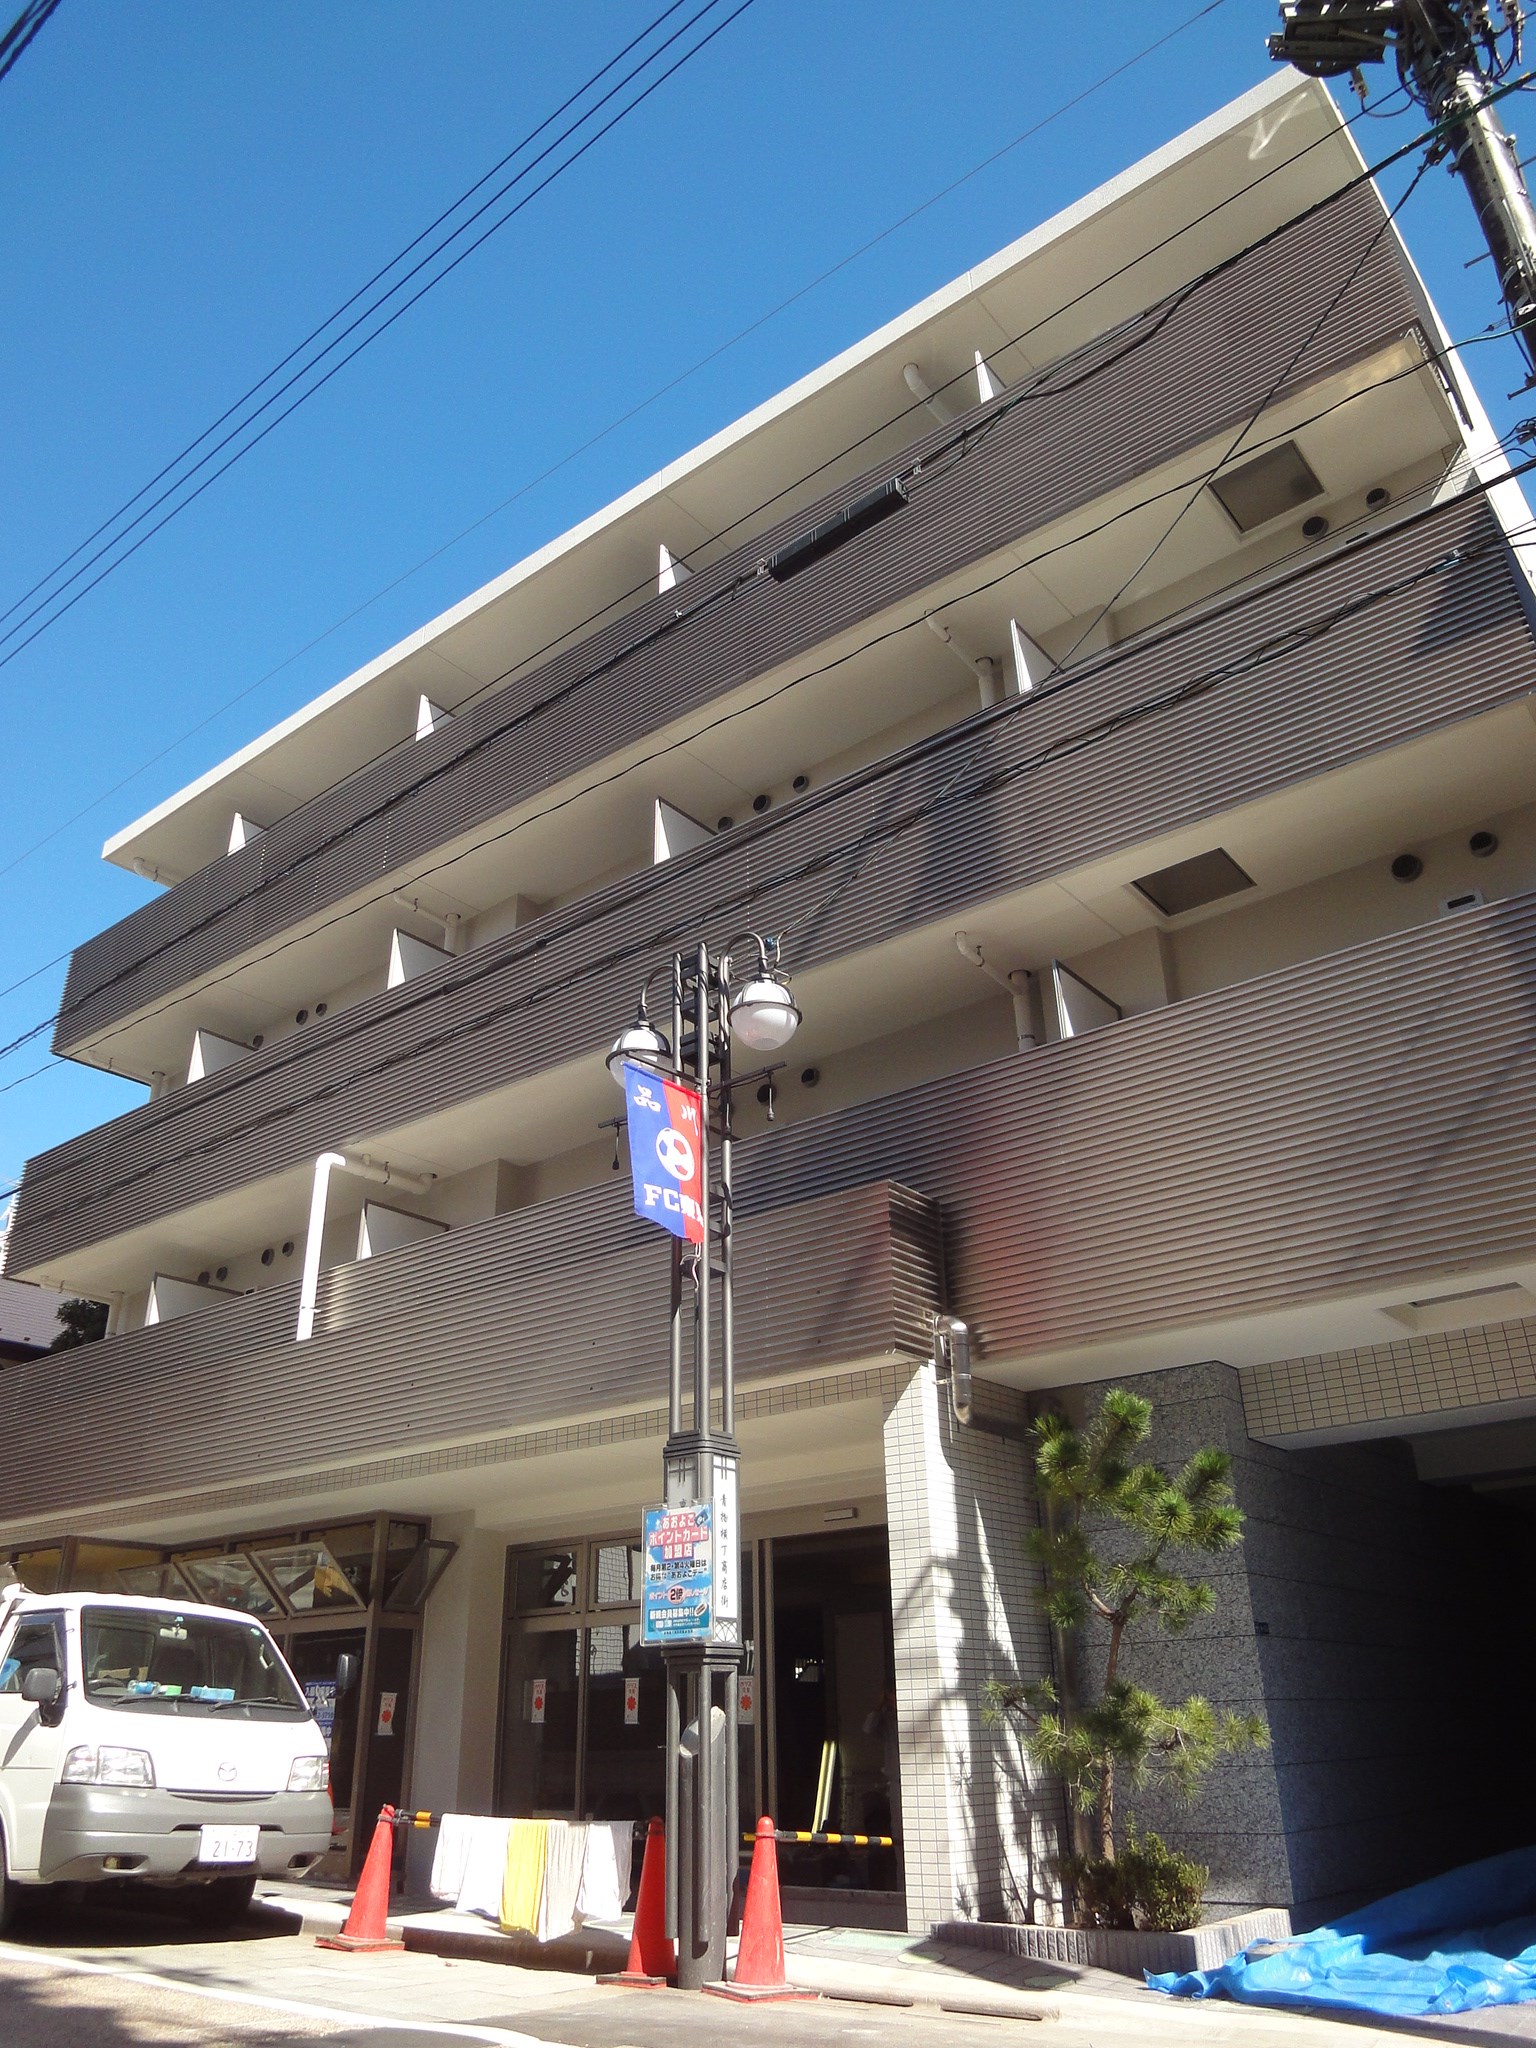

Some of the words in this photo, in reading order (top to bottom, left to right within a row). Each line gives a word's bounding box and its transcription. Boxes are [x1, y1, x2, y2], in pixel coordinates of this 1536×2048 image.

[663, 1513, 695, 1529] あおよこ
[649, 1526, 708, 1546] ポイントカード
[664, 1543, 693, 1560] 加盟店
[720, 1493, 730, 1609] 青物横丁商店街
